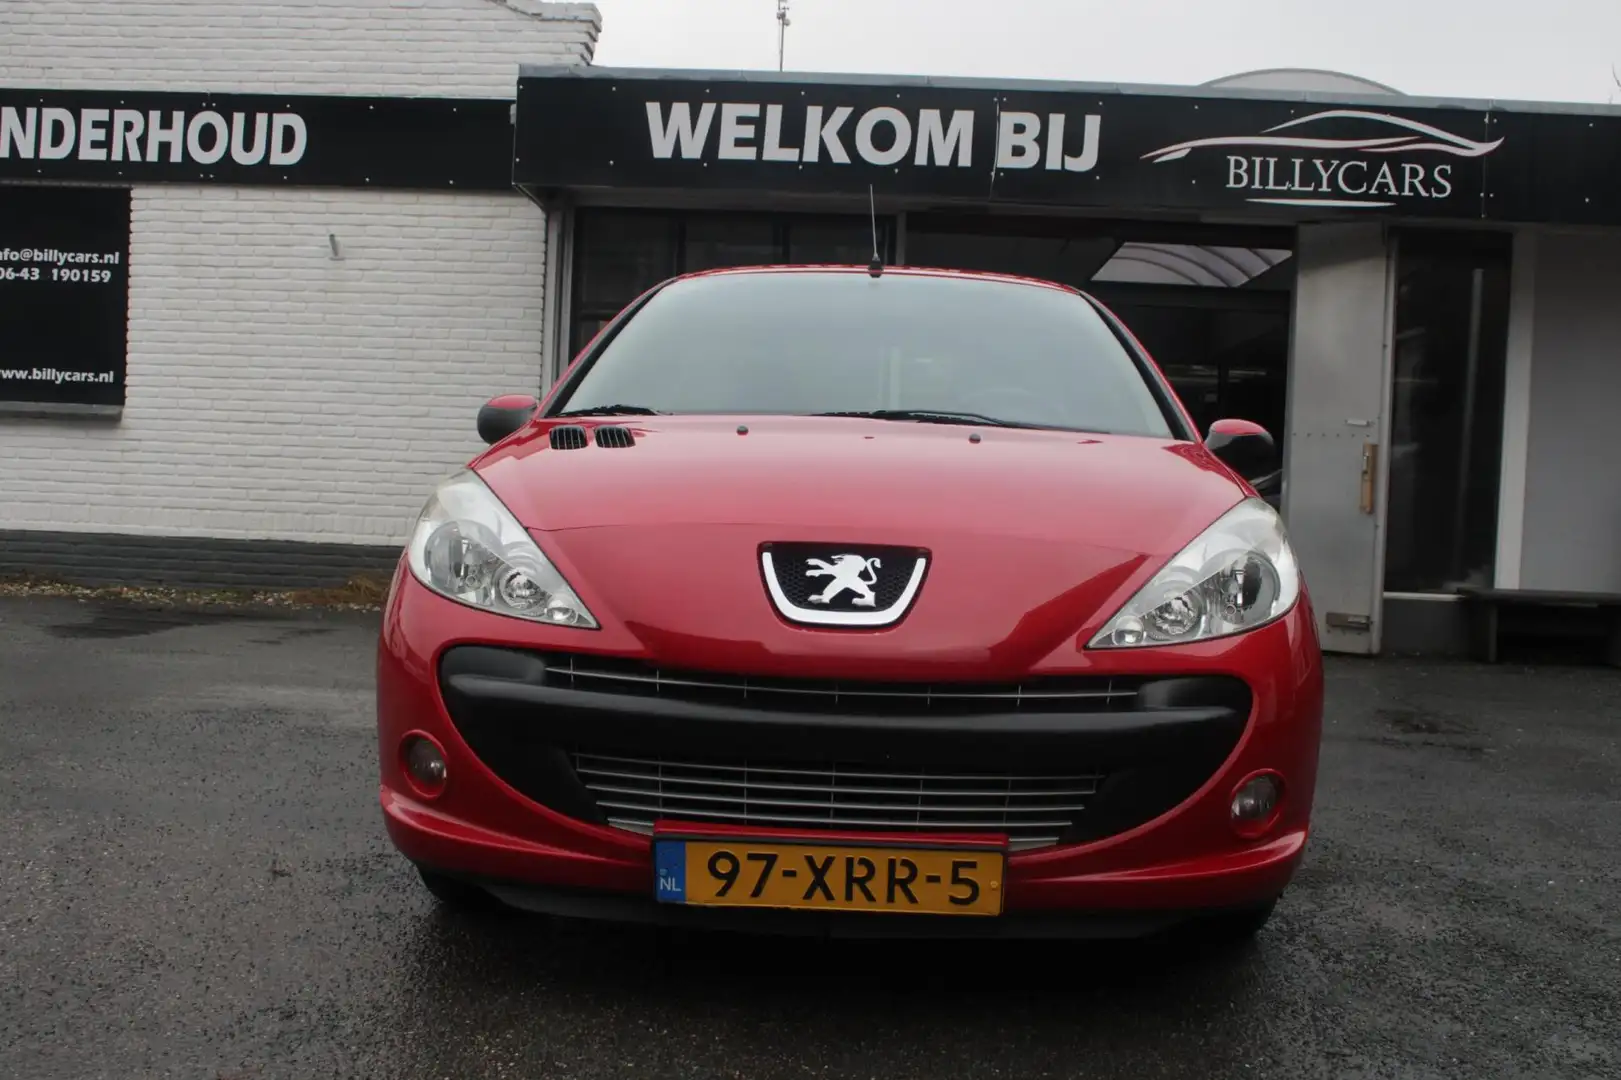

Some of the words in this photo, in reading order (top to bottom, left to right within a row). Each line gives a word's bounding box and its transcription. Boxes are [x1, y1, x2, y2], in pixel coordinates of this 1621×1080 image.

[0, 106, 307, 166] NDERHOUD
[645, 101, 975, 168] WELKOM
[996, 111, 1102, 172] BIJ
[1226, 155, 1452, 198] BILLYCARS
[0, 248, 120, 266] fo@billycars.nl
[51, 268, 112, 283] 190159
[0, 367, 114, 385] ww.billycars.nl
[659, 876, 682, 892] NL
[707, 850, 981, 906] 97-XRR-5
